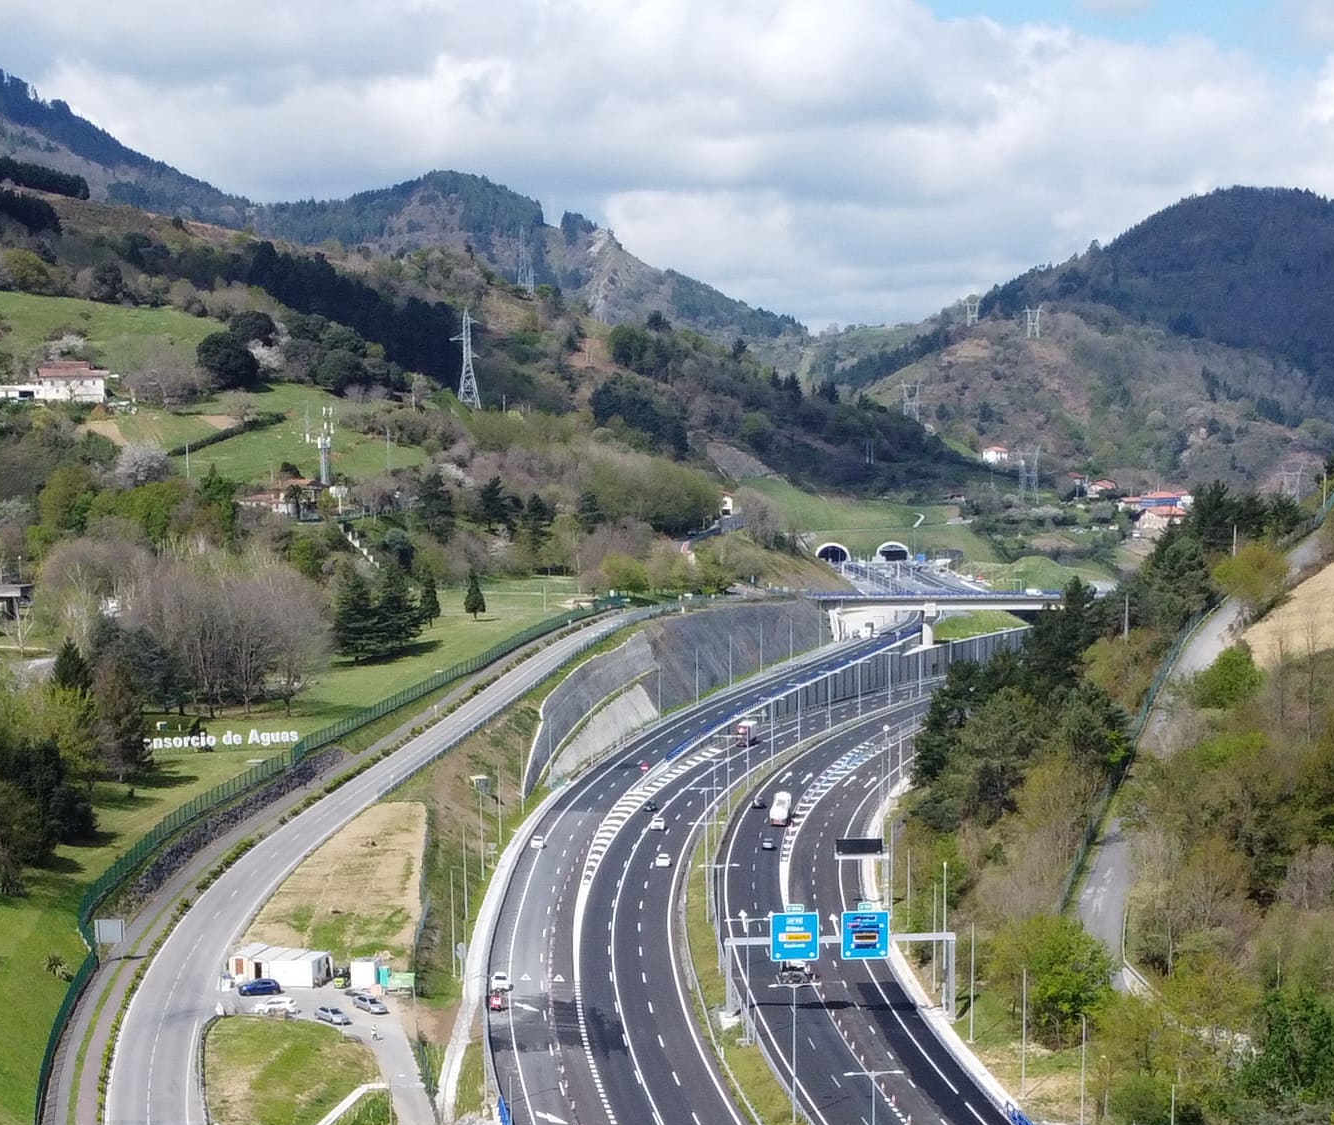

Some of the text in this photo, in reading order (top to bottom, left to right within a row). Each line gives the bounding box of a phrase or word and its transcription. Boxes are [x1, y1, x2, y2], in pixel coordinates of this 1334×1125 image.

[142, 728, 300, 750] onsorcio de Aguas
